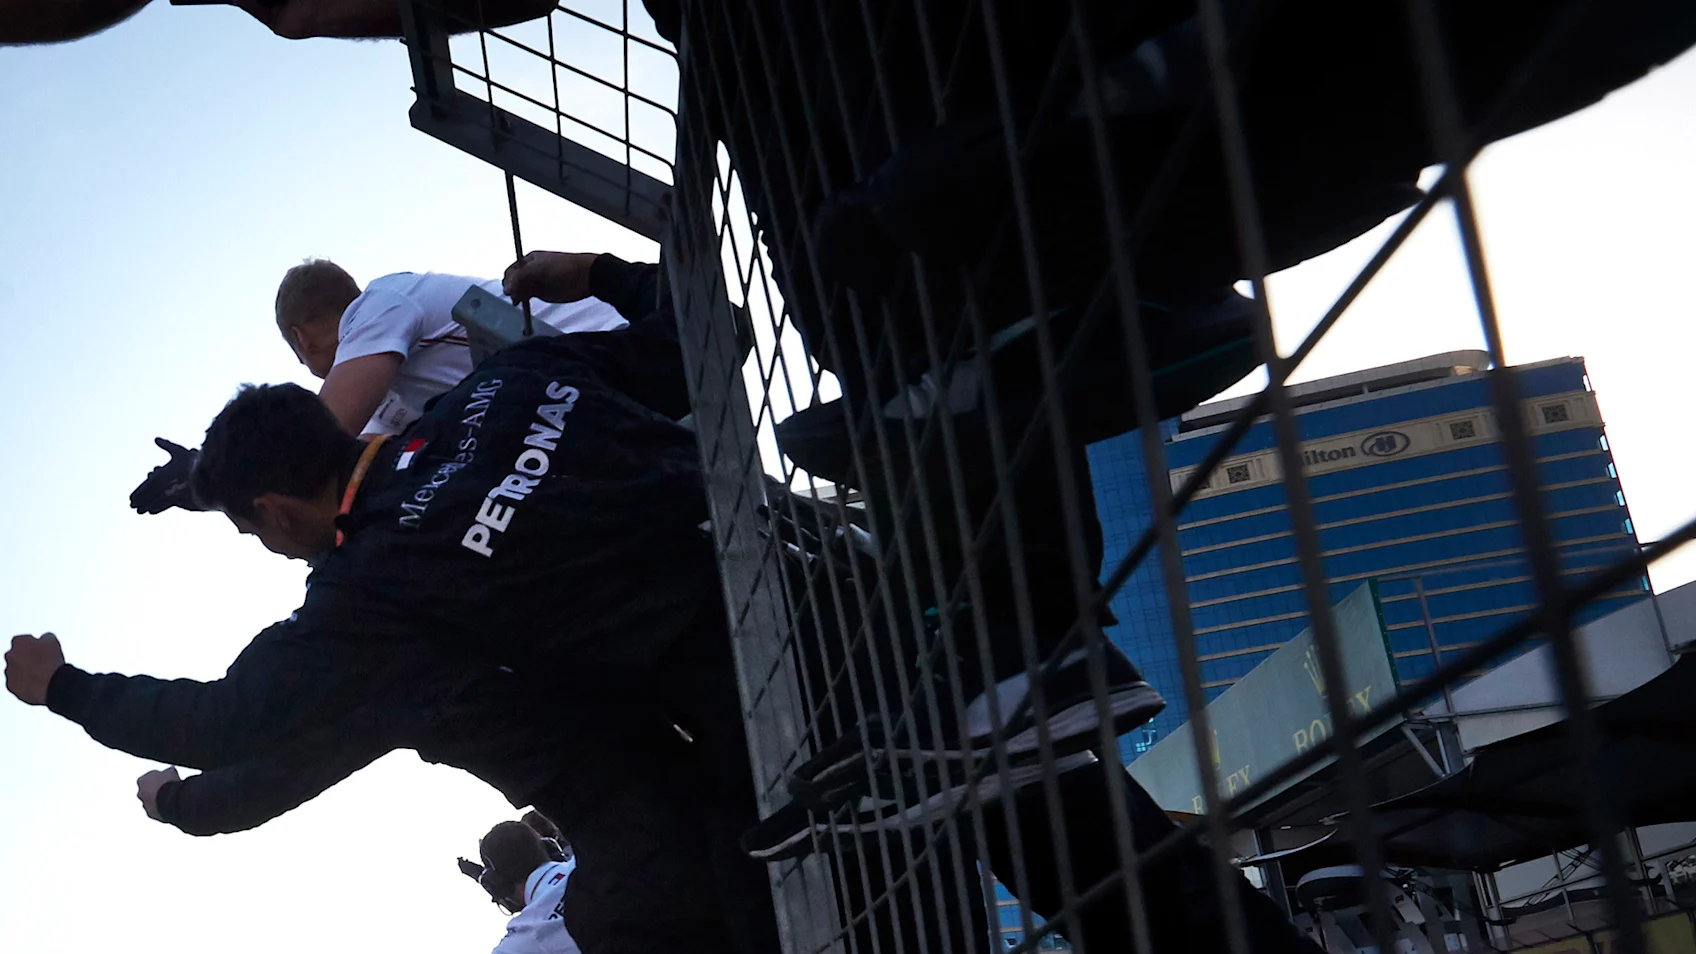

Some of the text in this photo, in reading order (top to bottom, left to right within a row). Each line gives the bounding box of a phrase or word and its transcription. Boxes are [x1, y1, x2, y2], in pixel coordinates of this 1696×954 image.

[461, 380, 581, 558] PETRONAS
[1302, 446, 1357, 466] ilton
[1292, 686, 1374, 754] ROX
